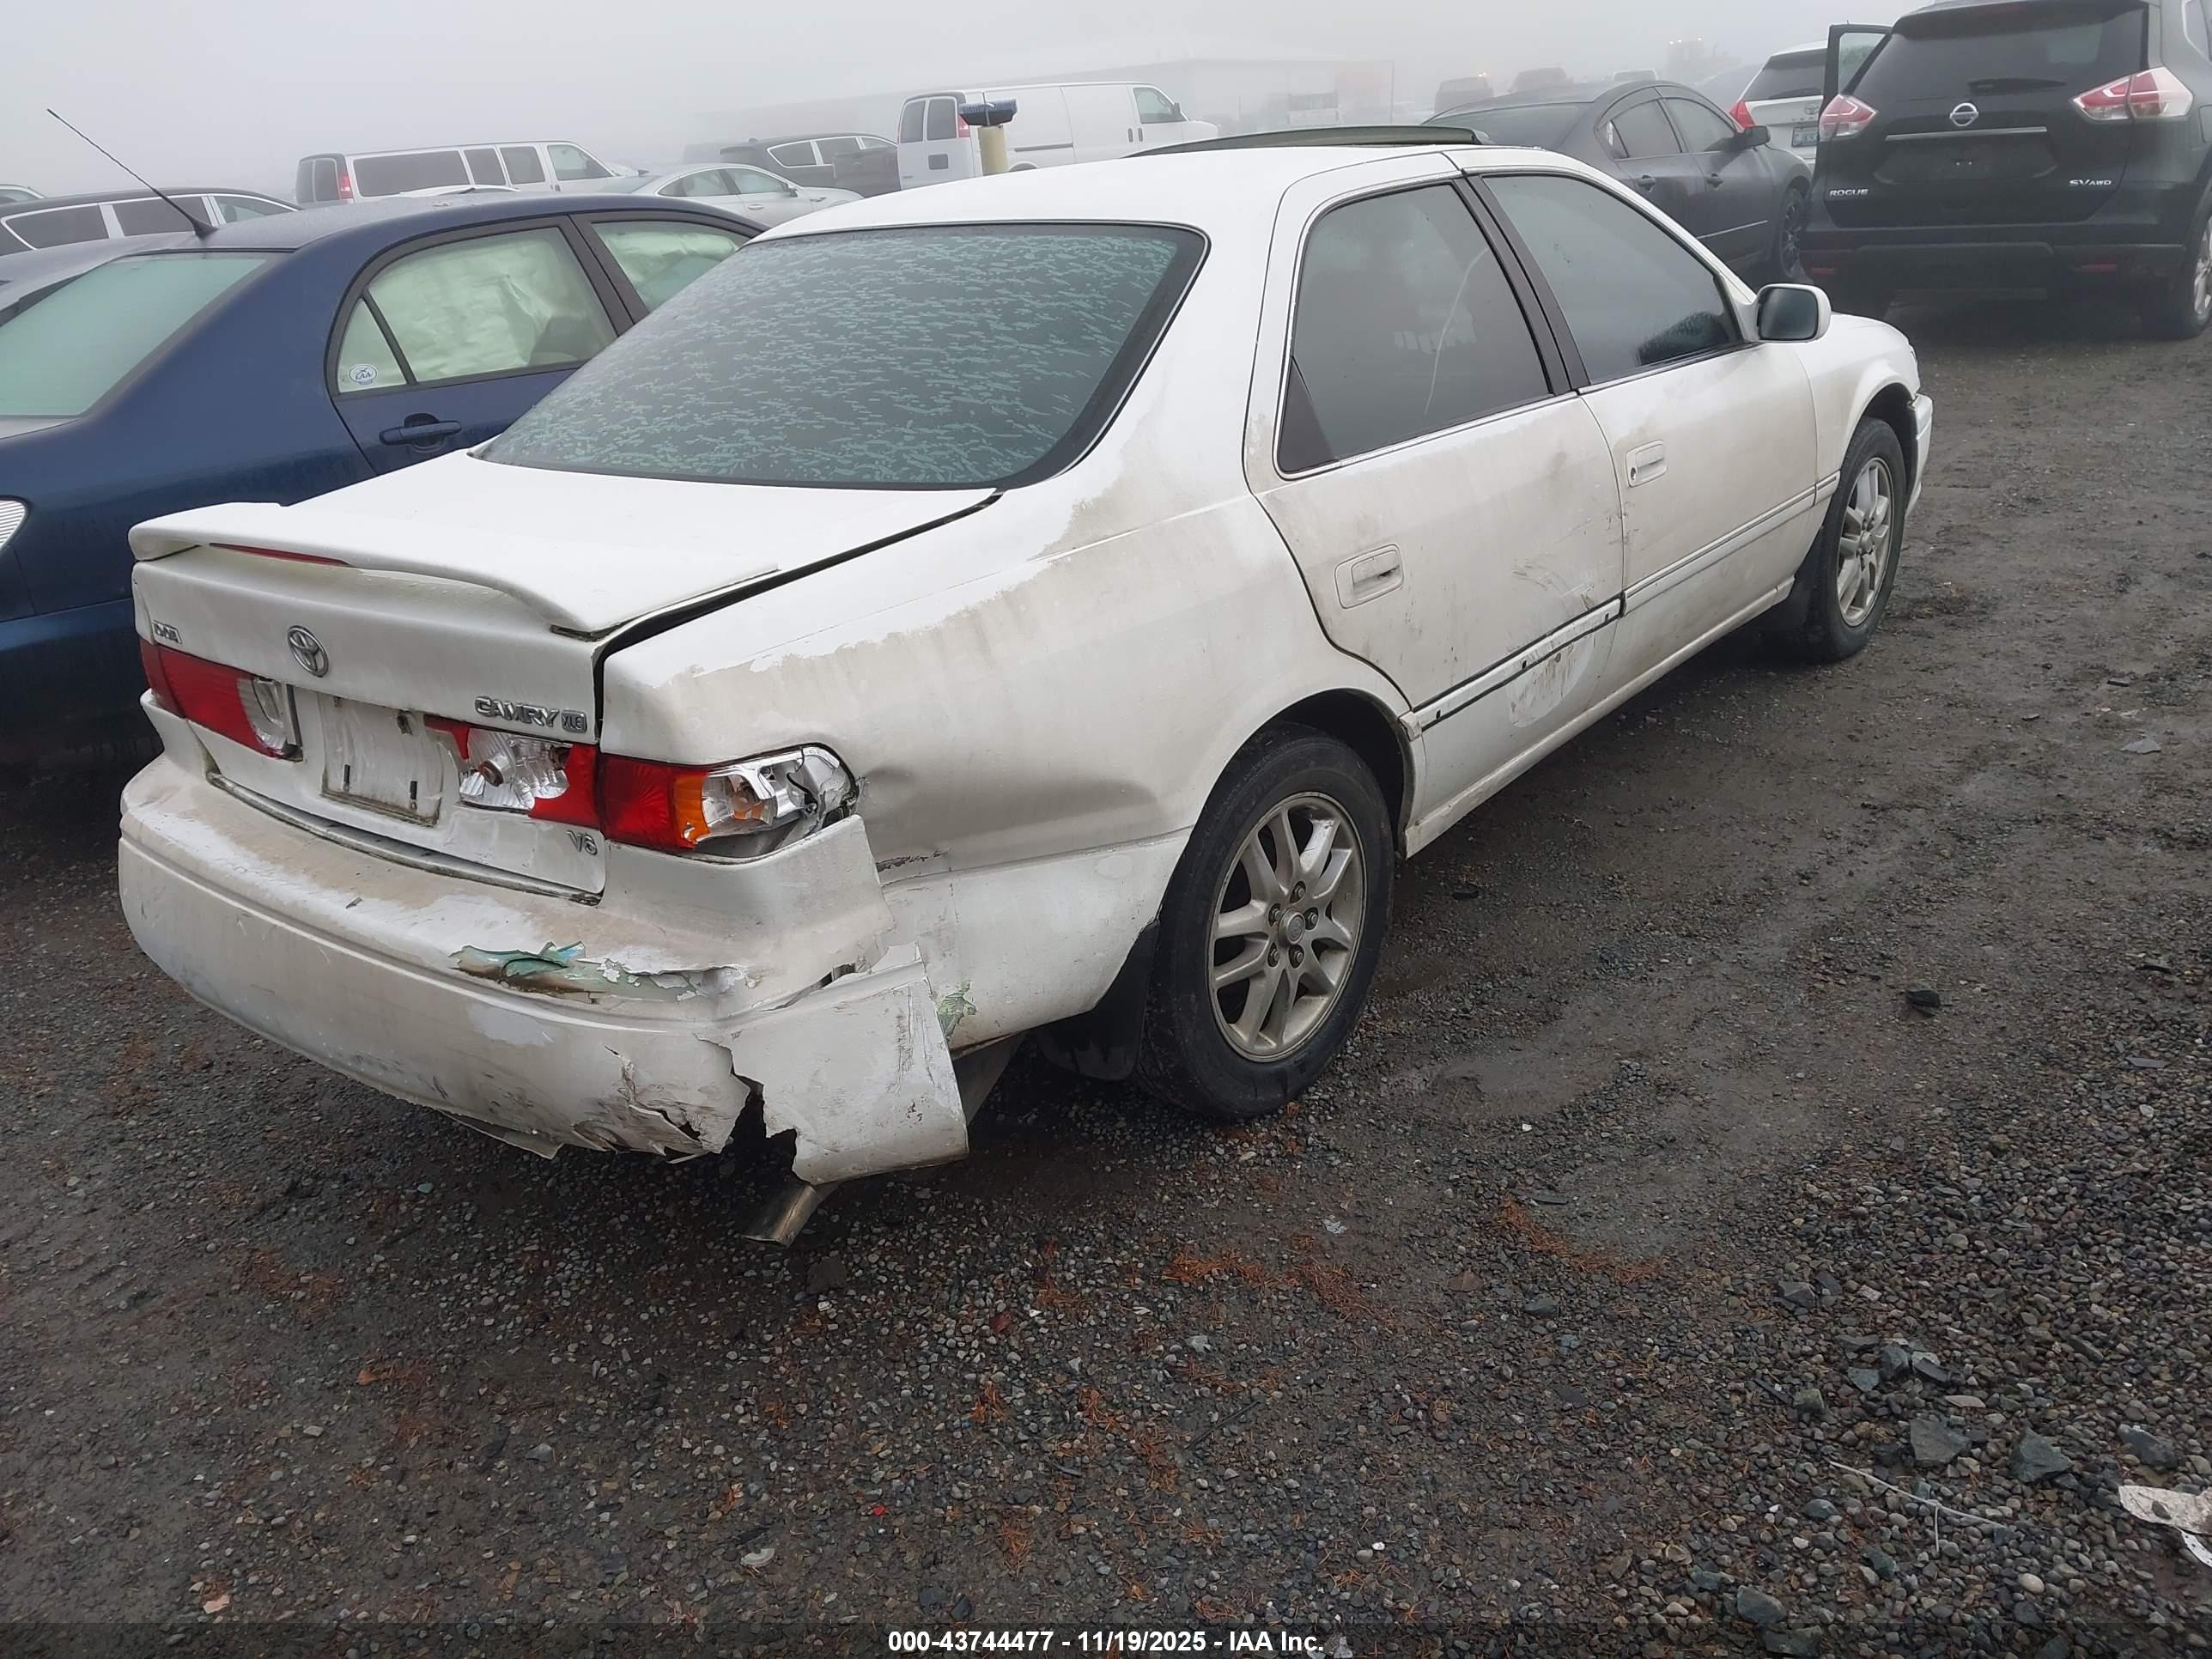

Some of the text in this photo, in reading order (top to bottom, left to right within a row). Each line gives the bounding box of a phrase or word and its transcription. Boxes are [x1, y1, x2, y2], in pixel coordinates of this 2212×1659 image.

[475, 696, 586, 731] CAMRY XLE
[566, 830, 599, 855] V6
